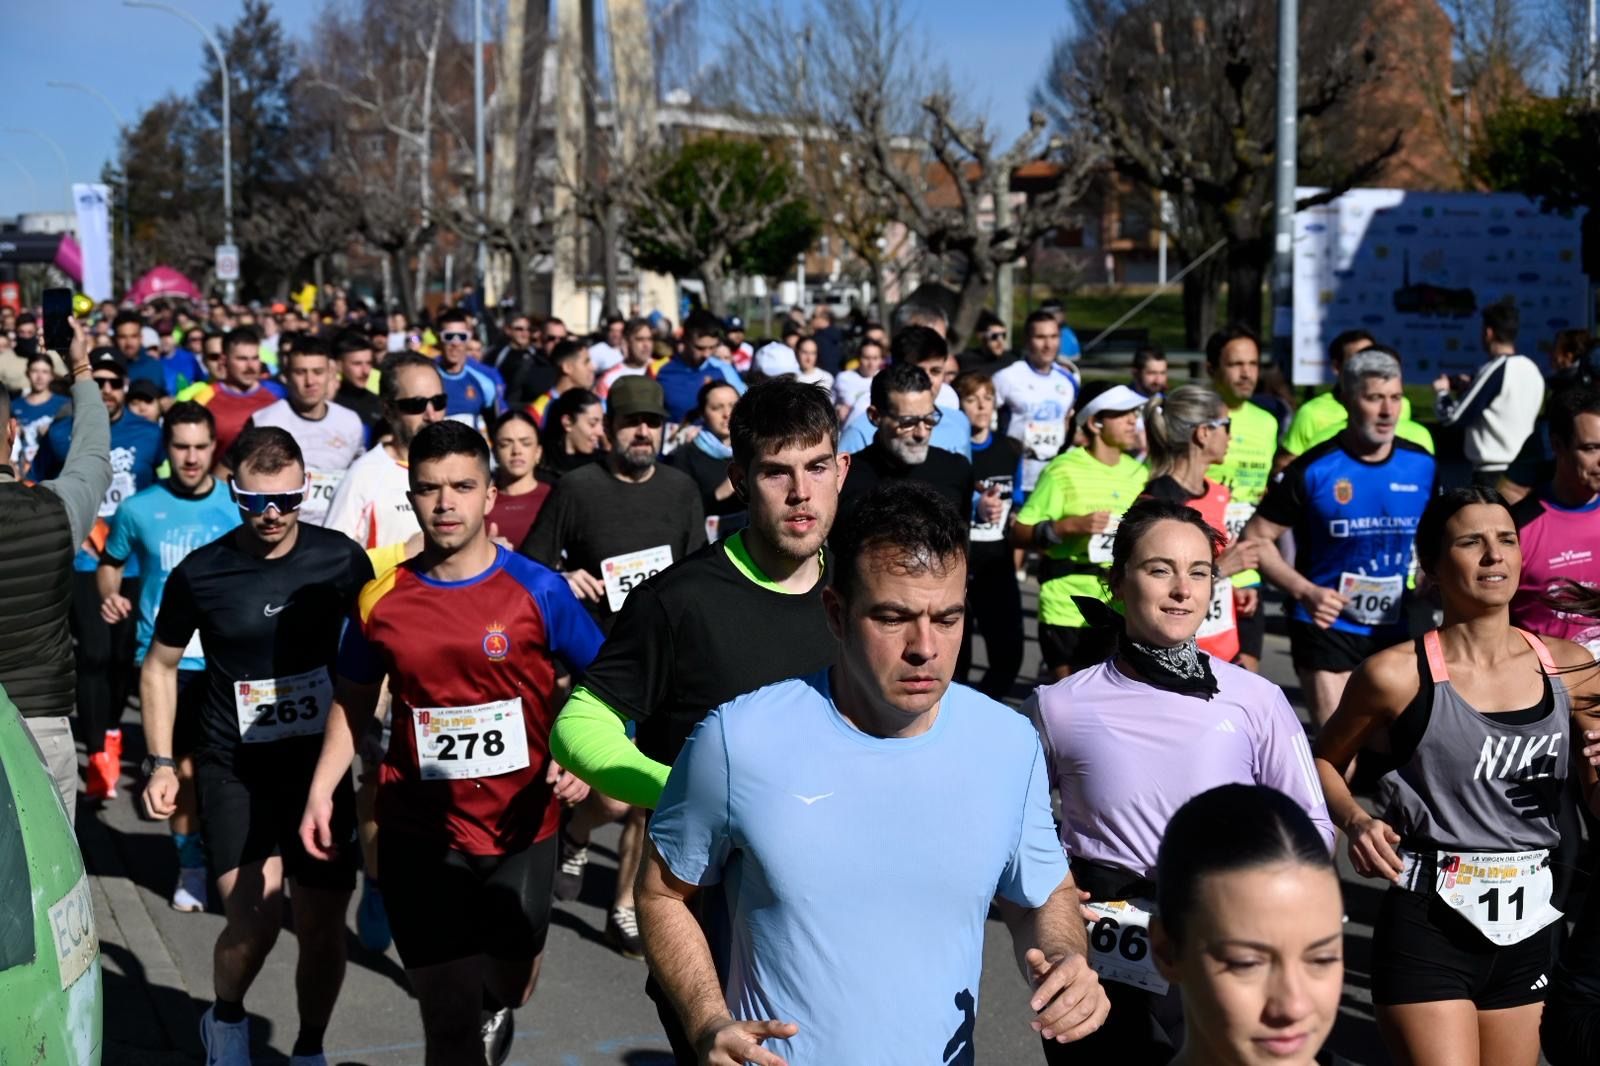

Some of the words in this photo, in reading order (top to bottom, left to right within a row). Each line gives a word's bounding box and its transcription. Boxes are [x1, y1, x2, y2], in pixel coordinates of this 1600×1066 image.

[1350, 516, 1420, 529] AREACLINIC
[1352, 594, 1391, 612] 106
[256, 695, 319, 726] 263
[435, 730, 505, 760] 278
[1473, 732, 1562, 780] NIKE
[1478, 886, 1525, 922] 11
